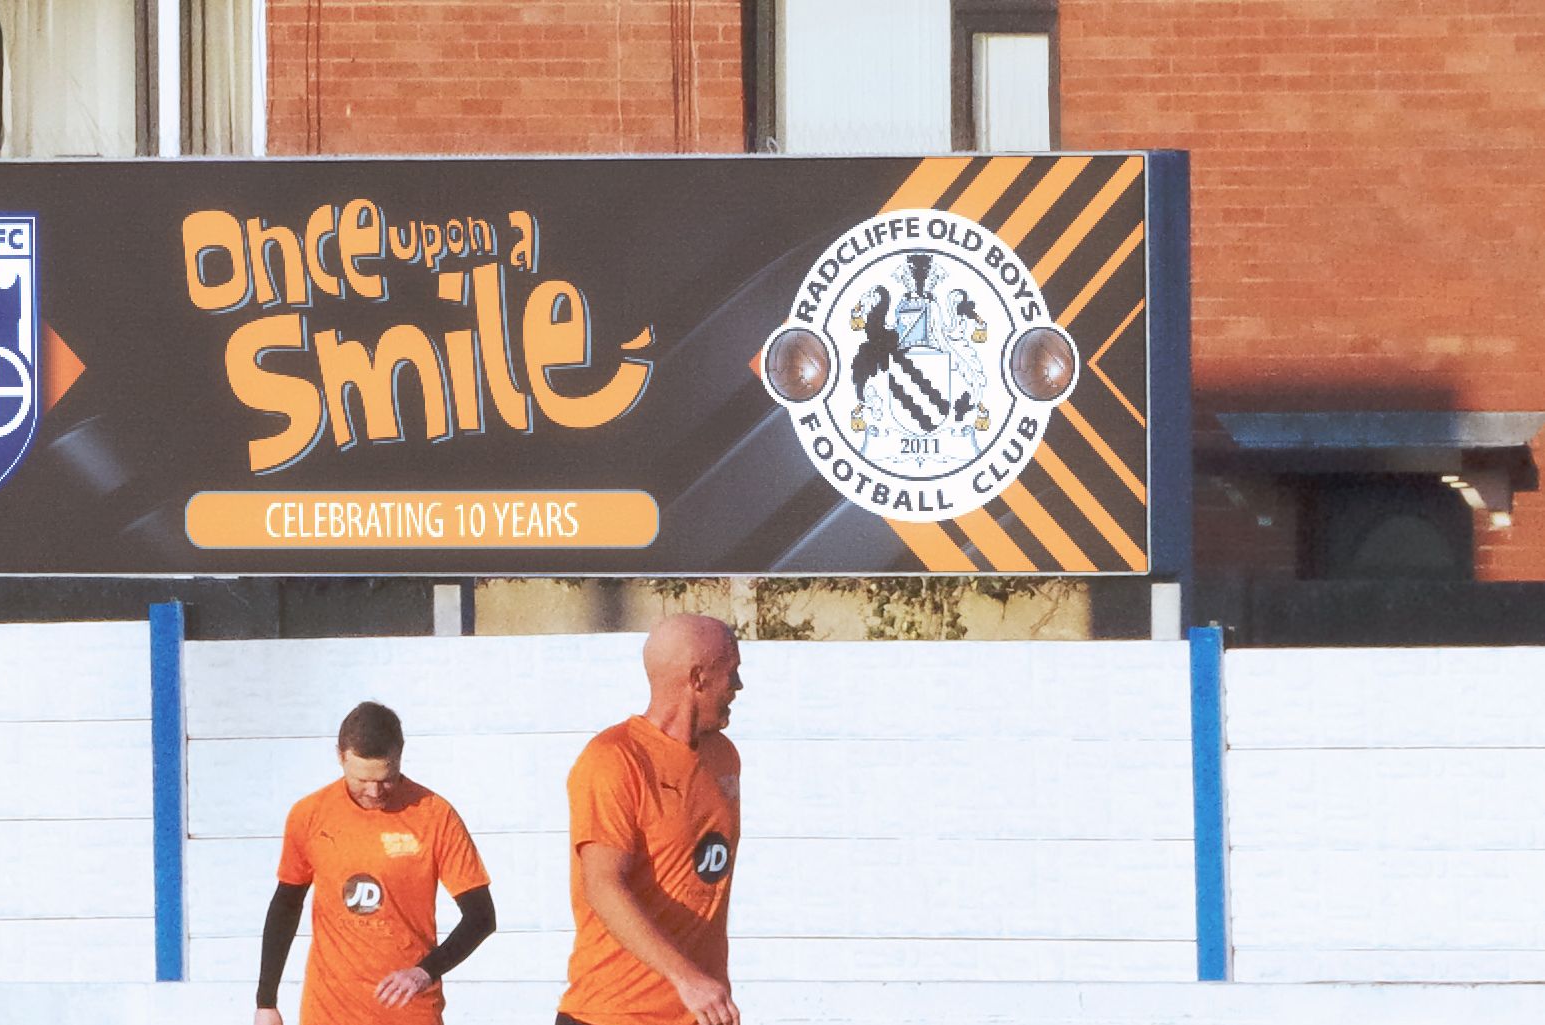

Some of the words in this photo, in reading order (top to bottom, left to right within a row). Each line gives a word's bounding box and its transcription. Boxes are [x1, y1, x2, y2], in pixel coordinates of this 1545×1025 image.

[388, 215, 498, 270] upon
[508, 210, 540, 272] a
[796, 216, 920, 324] RADCLIFFE
[926, 218, 984, 252] OLD
[984, 244, 1042, 323] BOYS
[799, 411, 954, 512] FOOTBALL
[971, 415, 1038, 495] CLUB
[899, 437, 941, 455] 2011
[265, 501, 445, 538] CELEBRATING
[454, 502, 486, 538] 10
[492, 501, 580, 538] YEARS
[697, 843, 728, 874] JD
[346, 881, 381, 908] JD
